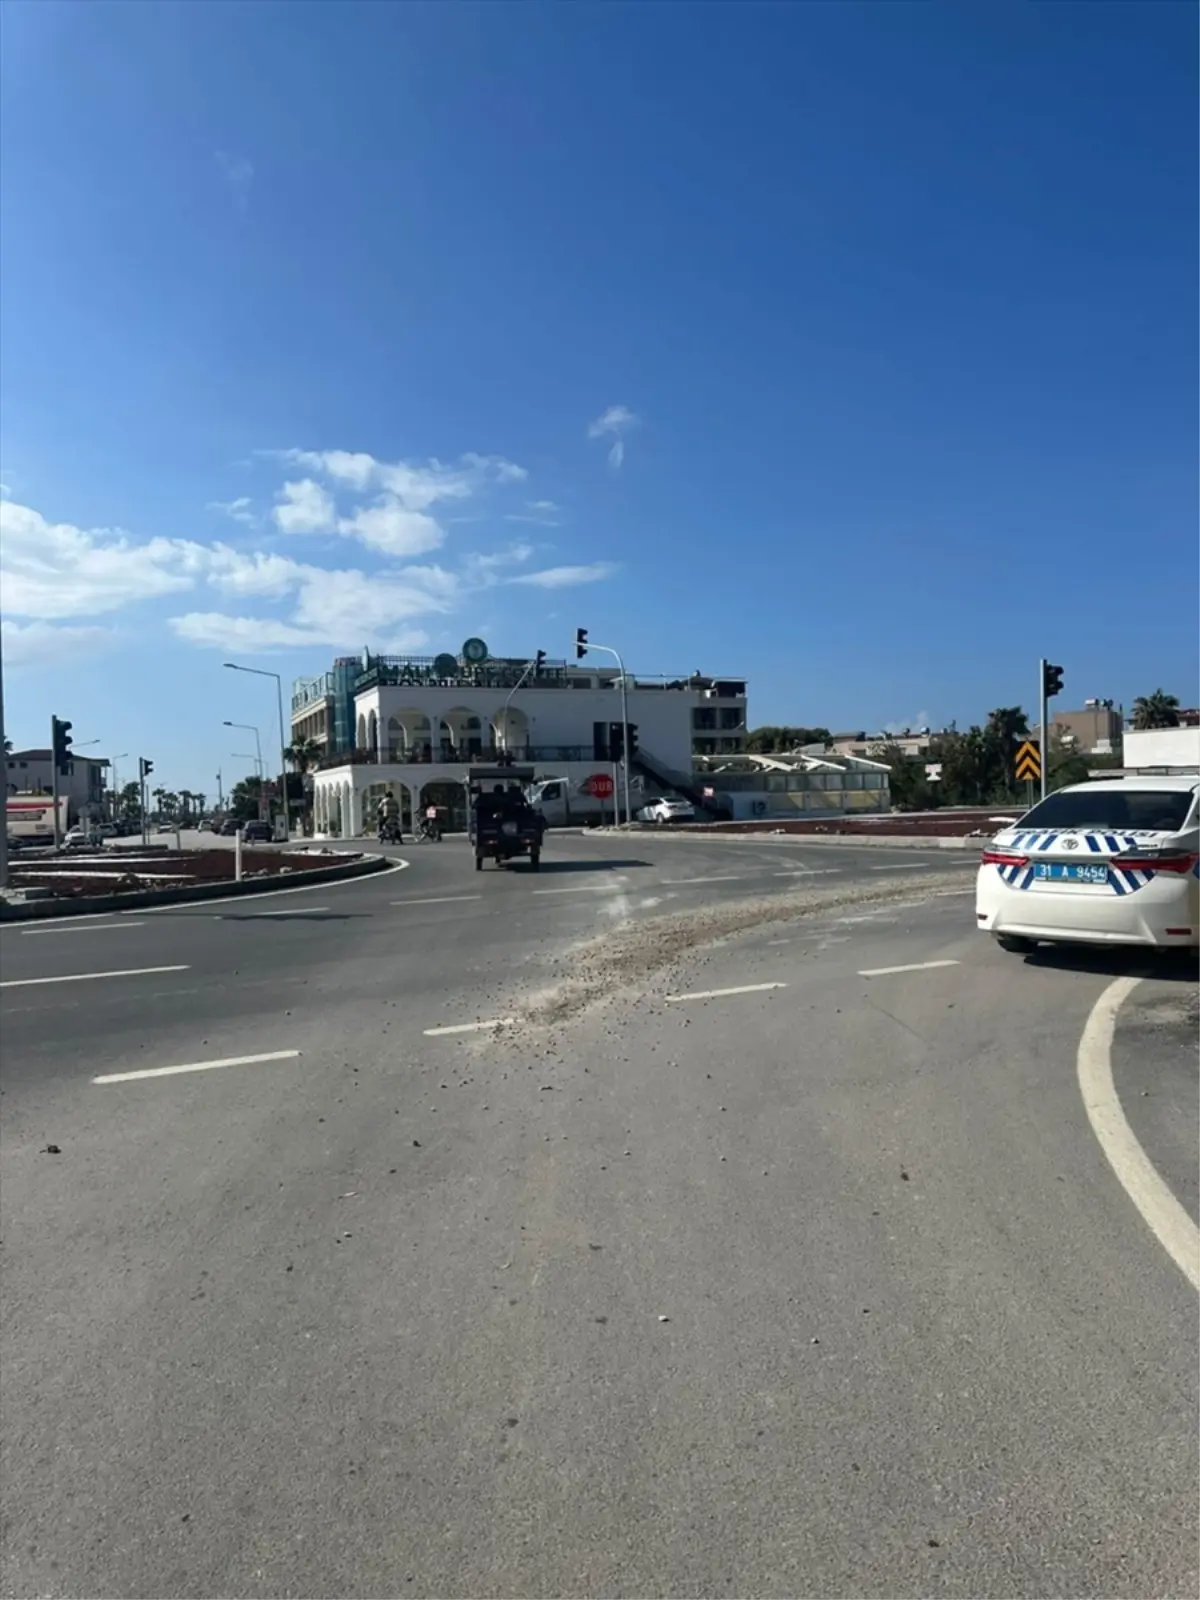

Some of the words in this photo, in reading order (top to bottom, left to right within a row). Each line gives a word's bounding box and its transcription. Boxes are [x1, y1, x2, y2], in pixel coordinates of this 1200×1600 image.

[590, 780, 613, 792] DUR
[1040, 864, 1052, 877] 31
[1061, 866, 1069, 878] A
[1076, 865, 1105, 879] 9454
